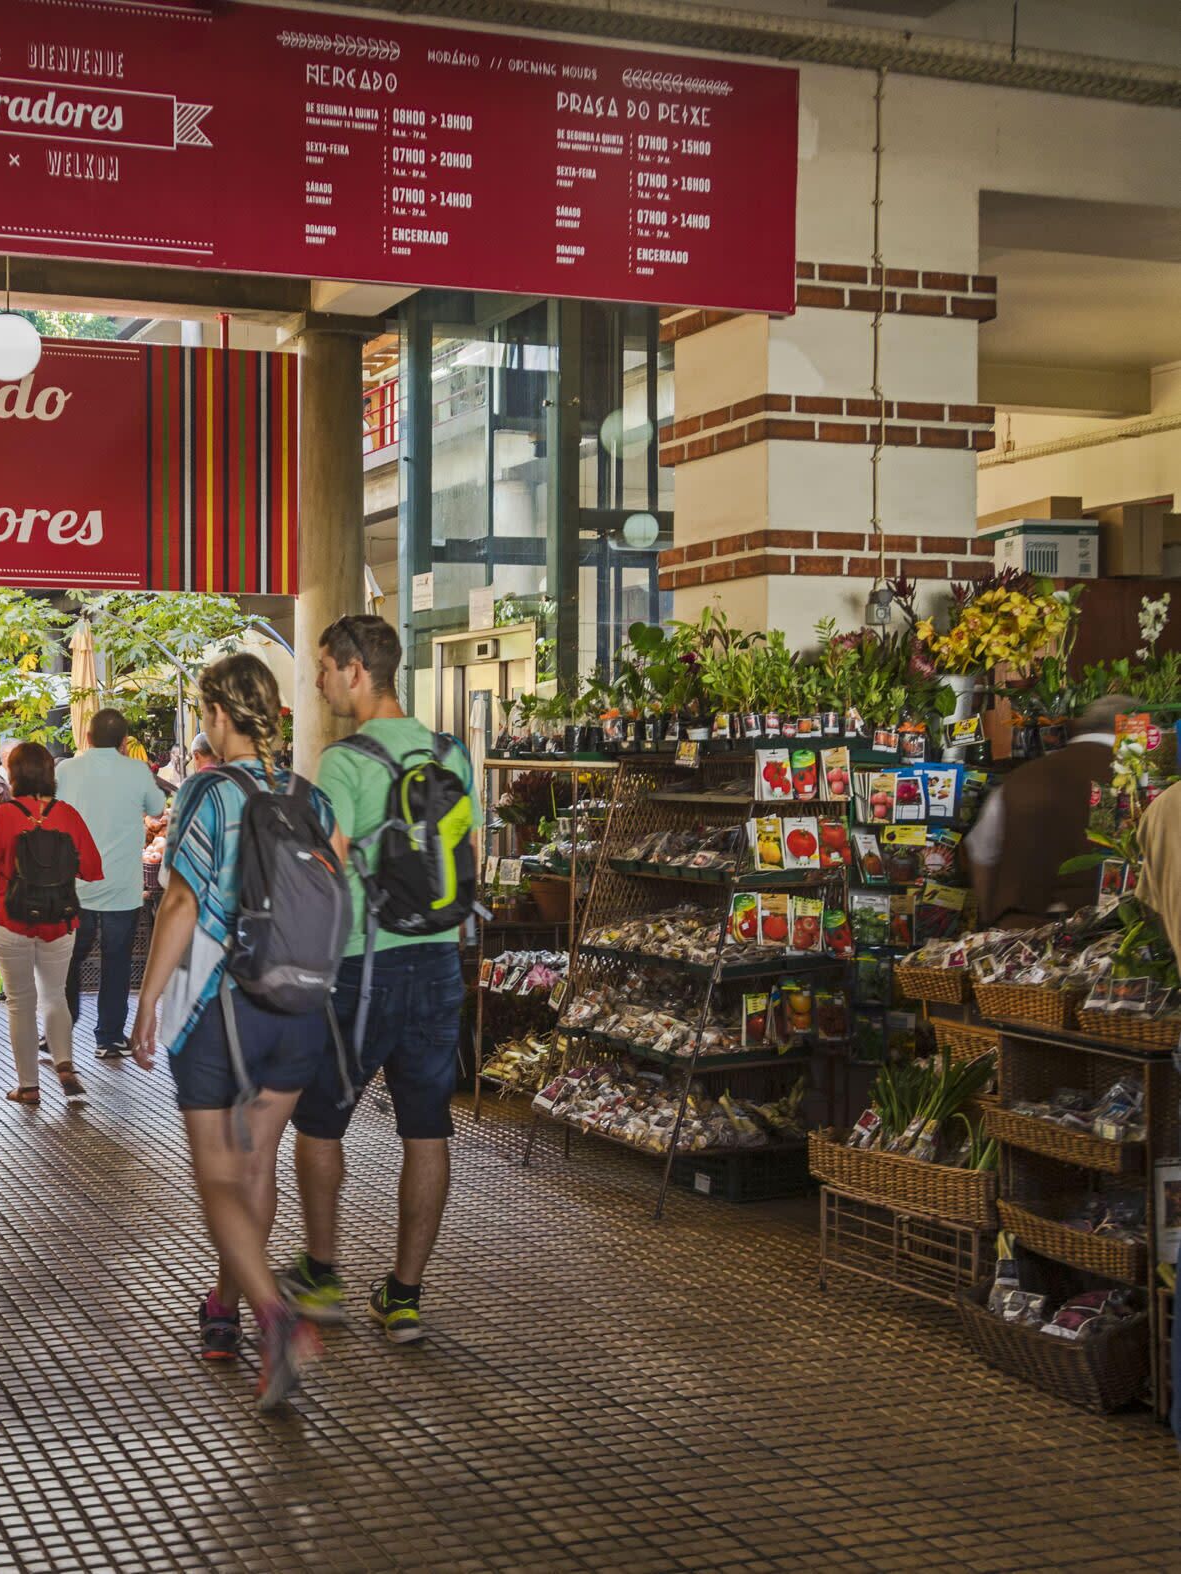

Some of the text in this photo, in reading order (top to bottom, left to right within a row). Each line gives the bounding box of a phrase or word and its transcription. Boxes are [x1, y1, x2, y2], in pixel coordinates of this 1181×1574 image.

[27, 41, 124, 78] BIENVENUE
[307, 64, 398, 93] MERCADO
[317, 104, 348, 117] SEGUNDA
[349, 107, 354, 118] A
[355, 108, 379, 120] QUINTA
[557, 92, 711, 127] PRAÇA DO PEIXE
[306, 117, 321, 126] FROM
[322, 119, 343, 128] MONDAY
[352, 121, 378, 131] THURSDAY
[393, 108, 473, 131] 08H00 19H00
[557, 129, 624, 145] DE SEGUNDA A QUINTA
[306, 142, 350, 158] SEXTA-FEIRA
[638, 135, 711, 156] 07H00 15H00
[46, 149, 121, 182] WELKOM
[306, 156, 324, 164] FRIDAY
[393, 147, 473, 169] 07H00 20H00
[557, 166, 597, 179] SEXTA-FEIRA
[306, 181, 333, 194] SÁBADO
[557, 179, 574, 188] FRIDAY
[638, 172, 711, 193] 07H00 16H00
[306, 195, 332, 205] SATURDAY
[393, 187, 473, 209] 07H00 14H00
[556, 206, 581, 218] SÁBADO
[637, 209, 711, 230] 07H00 14H00
[306, 224, 337, 238] DOMINGO
[393, 228, 449, 245] ENCERRADO
[306, 236, 326, 245] SUNDAY
[392, 247, 412, 256] CLOSED
[557, 245, 585, 256] DOMINGO
[637, 248, 689, 265] ENCERRADO
[557, 257, 575, 265] SUNDAY
